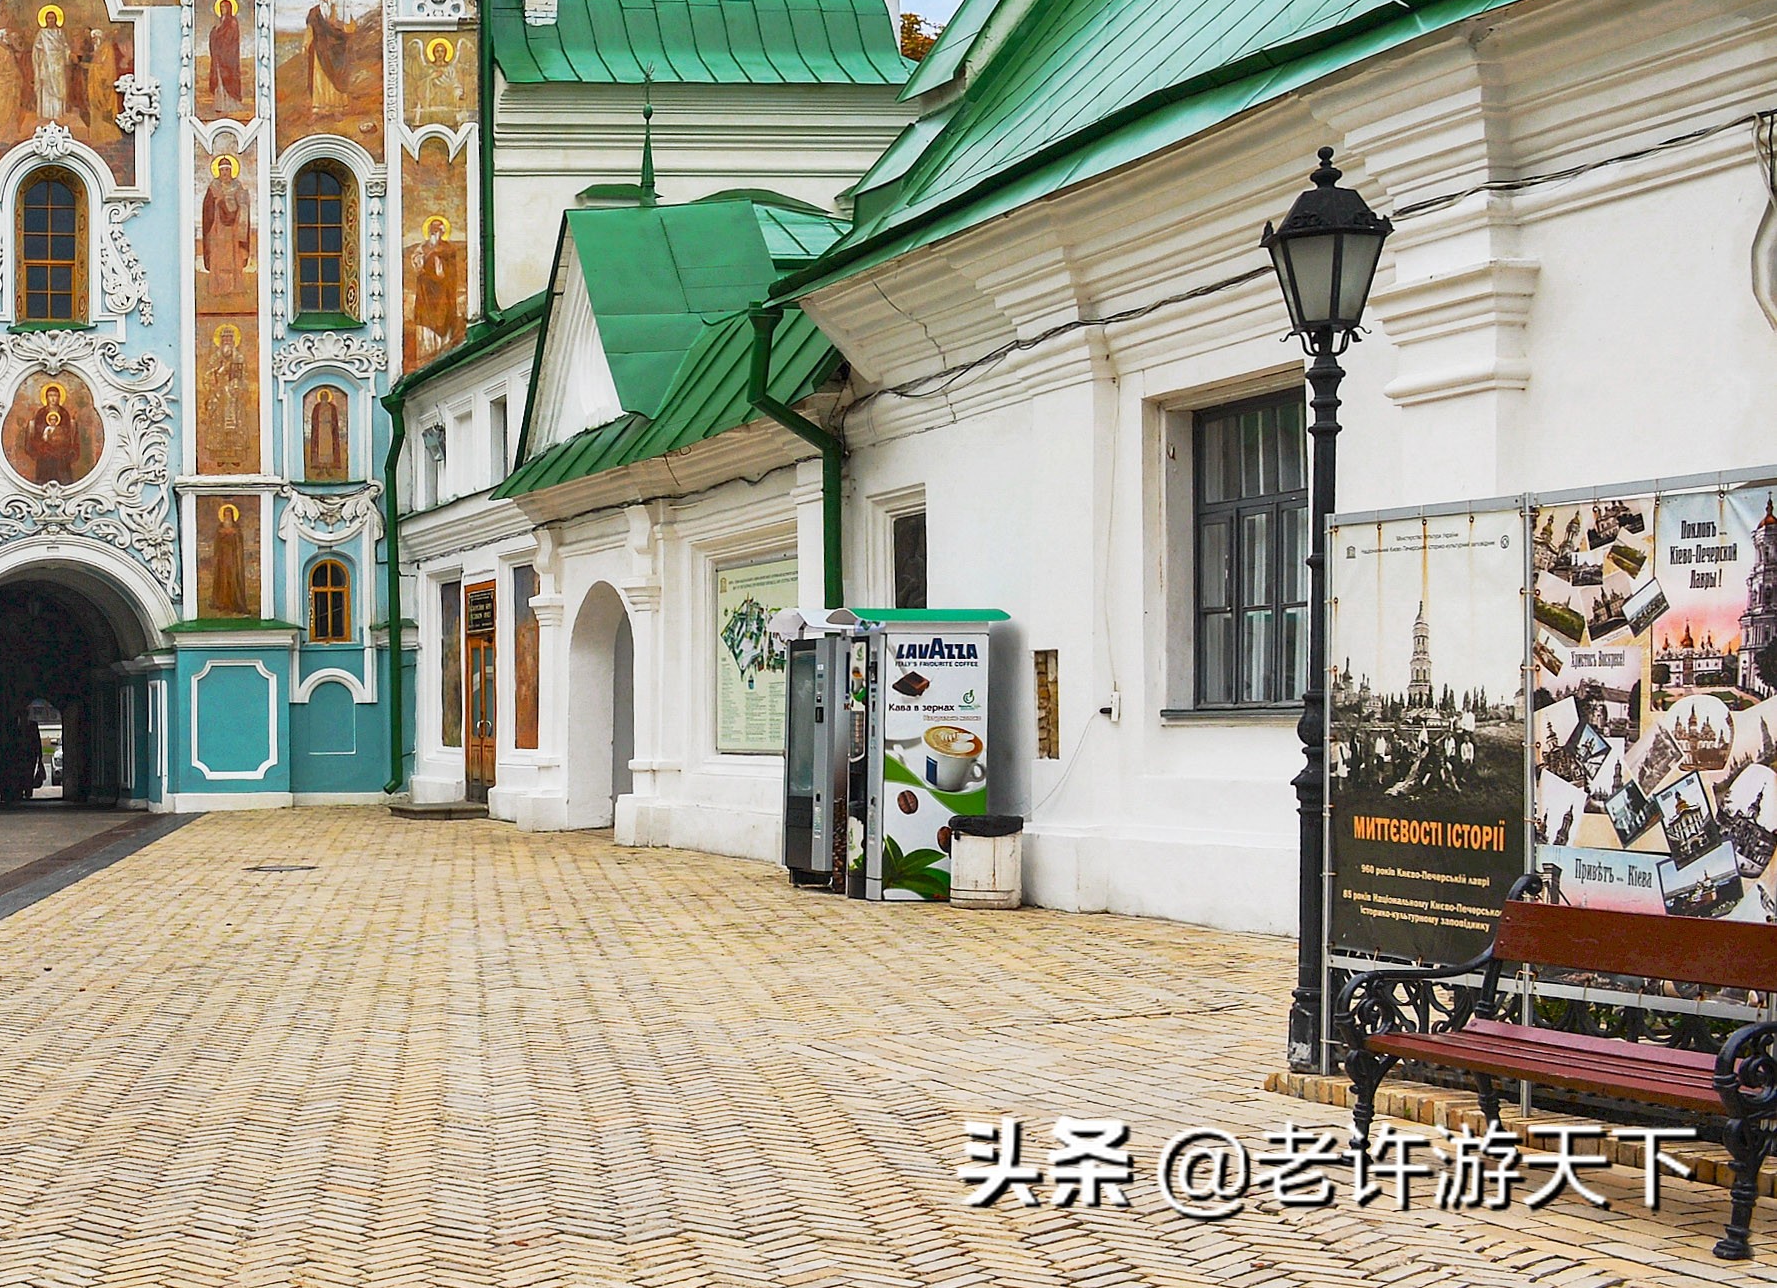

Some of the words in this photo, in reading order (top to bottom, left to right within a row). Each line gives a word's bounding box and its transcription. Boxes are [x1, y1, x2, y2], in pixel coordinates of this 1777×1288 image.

[896, 637, 978, 659] LAVAZZA
[888, 703, 911, 711] Кава
[922, 704, 955, 713] зернах
[1353, 815, 1443, 847] МИТТЄВОСТІ
[1447, 820, 1506, 852] ІСТОРІЇ
[1375, 866, 1396, 877] років
[1353, 891, 1372, 902] років
